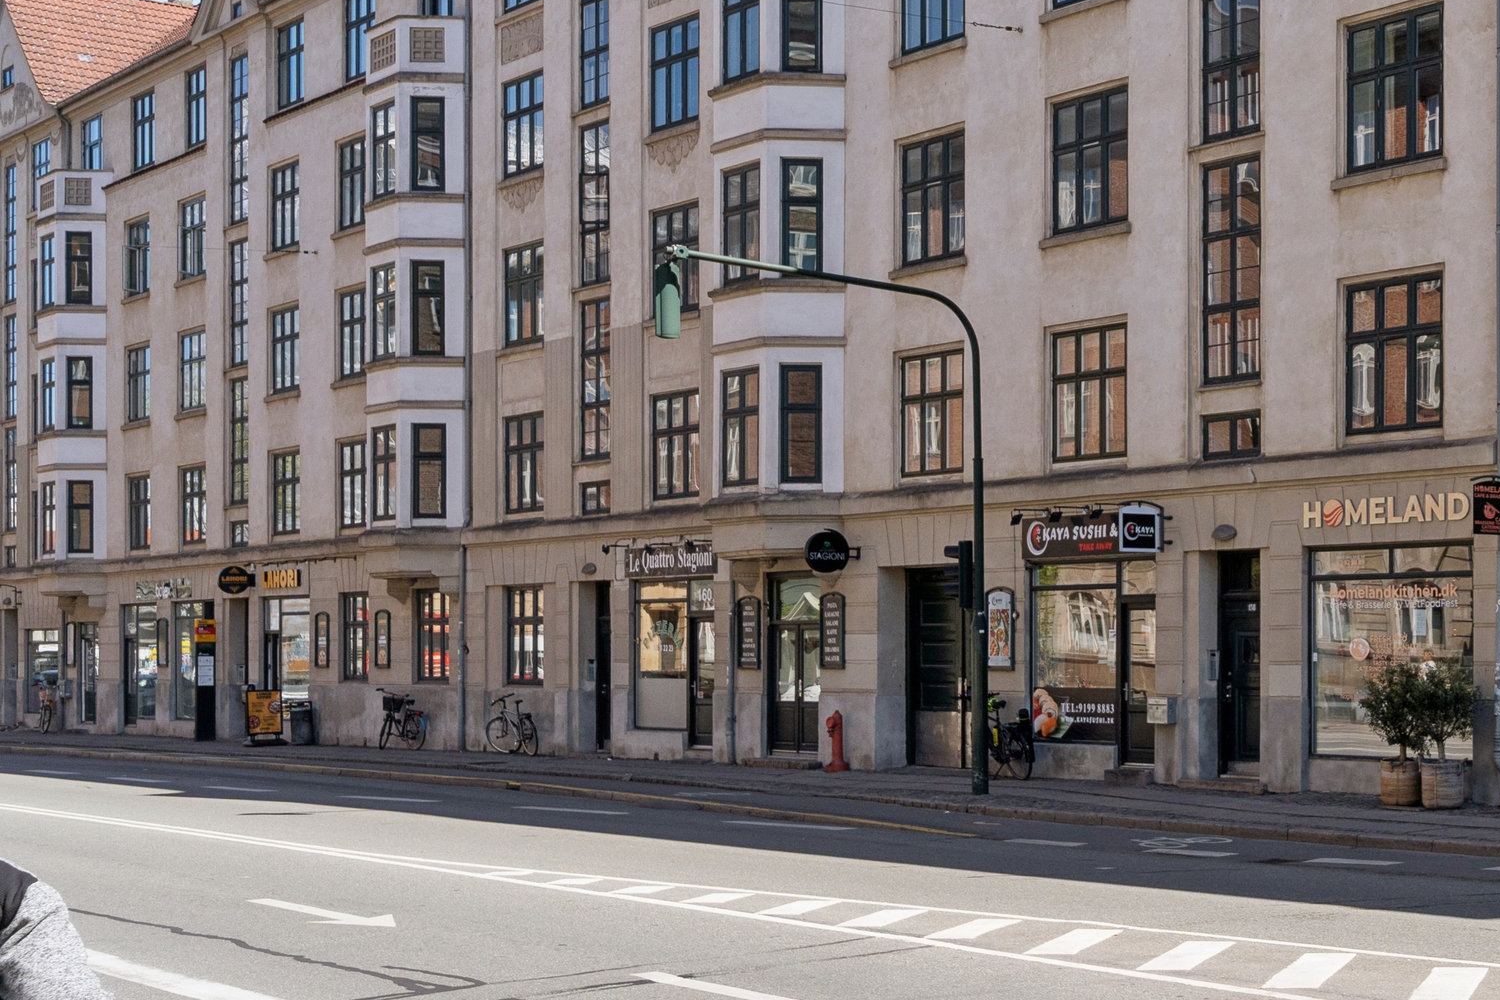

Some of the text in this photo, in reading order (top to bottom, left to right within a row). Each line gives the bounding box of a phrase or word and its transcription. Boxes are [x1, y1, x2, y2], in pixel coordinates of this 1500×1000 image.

[1303, 492, 1470, 529] HOMELAND
[1042, 526, 1070, 541] KAYA
[1073, 523, 1107, 540] SUSHI
[1135, 526, 1154, 534] KAYA
[1079, 543, 1094, 551] TAKE
[629, 546, 713, 573] Le Quattro Stagioni
[809, 552, 845, 560] STAGIONI
[261, 569, 299, 589] LAHORI
[697, 588, 713, 601] 160
[1356, 600, 1391, 609] Brasserie
[1096, 703, 1115, 714] 8883
